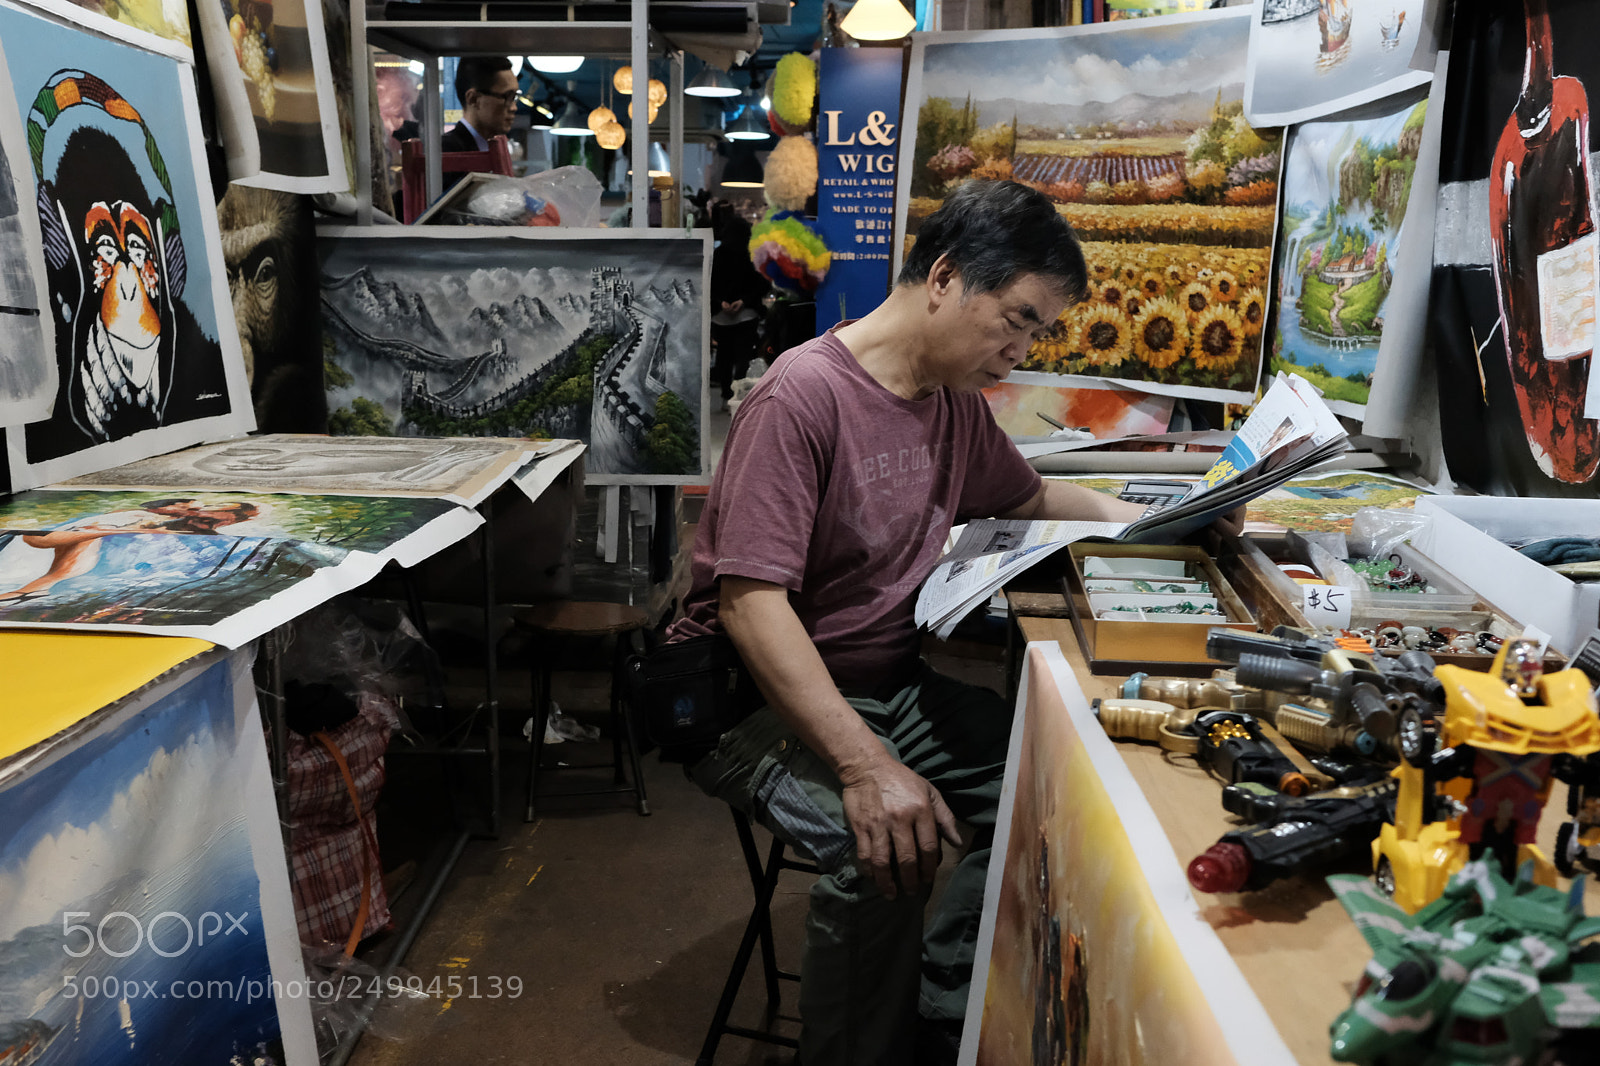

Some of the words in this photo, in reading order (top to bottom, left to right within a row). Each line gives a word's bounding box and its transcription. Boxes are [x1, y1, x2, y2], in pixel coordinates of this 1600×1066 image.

[838, 154, 895, 173] WIG
[823, 178, 859, 186] RETAIL
[861, 178, 868, 186] &
[832, 205, 860, 213] MADE
[863, 205, 877, 214] TO
[1307, 588, 1345, 612] $5
